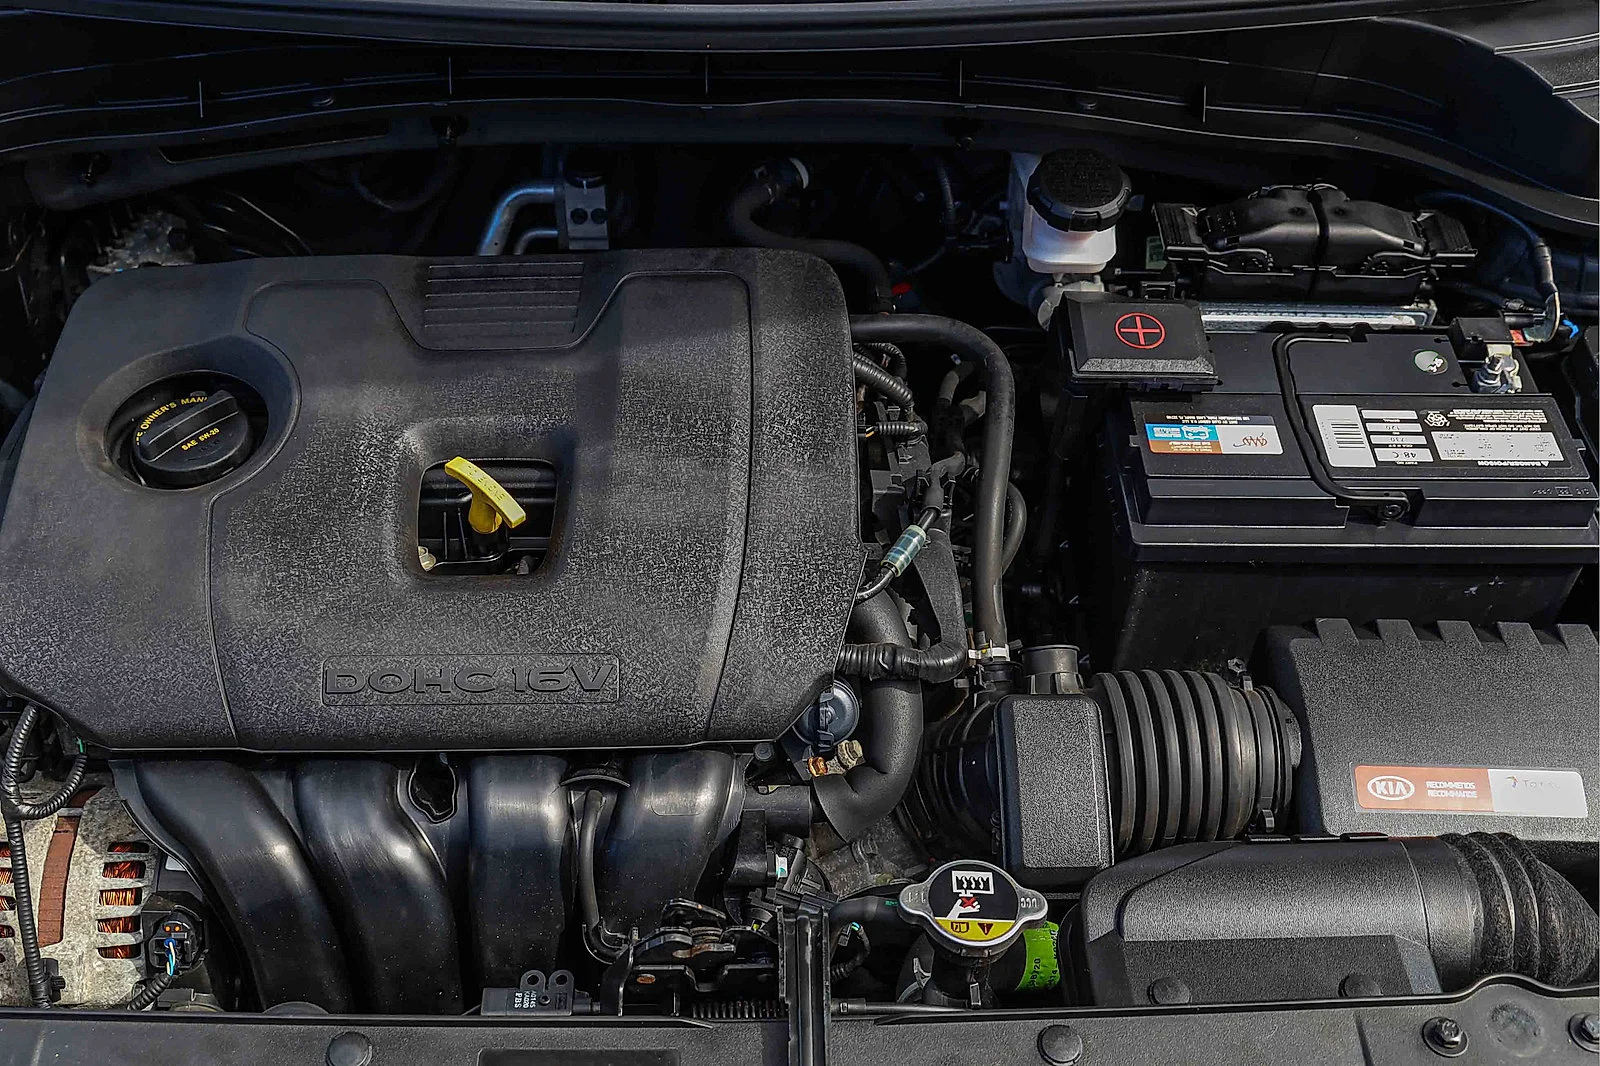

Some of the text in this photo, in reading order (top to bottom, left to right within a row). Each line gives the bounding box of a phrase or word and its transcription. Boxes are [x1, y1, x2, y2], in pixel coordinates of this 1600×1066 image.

[140, 402, 177, 430] OWNER'S
[181, 440, 198, 451] SAE
[198, 428, 220, 441] 5W-20
[325, 666, 613, 694] DOHC 16V
[1374, 780, 1408, 795] KIA
[514, 992, 523, 1008] PBS
